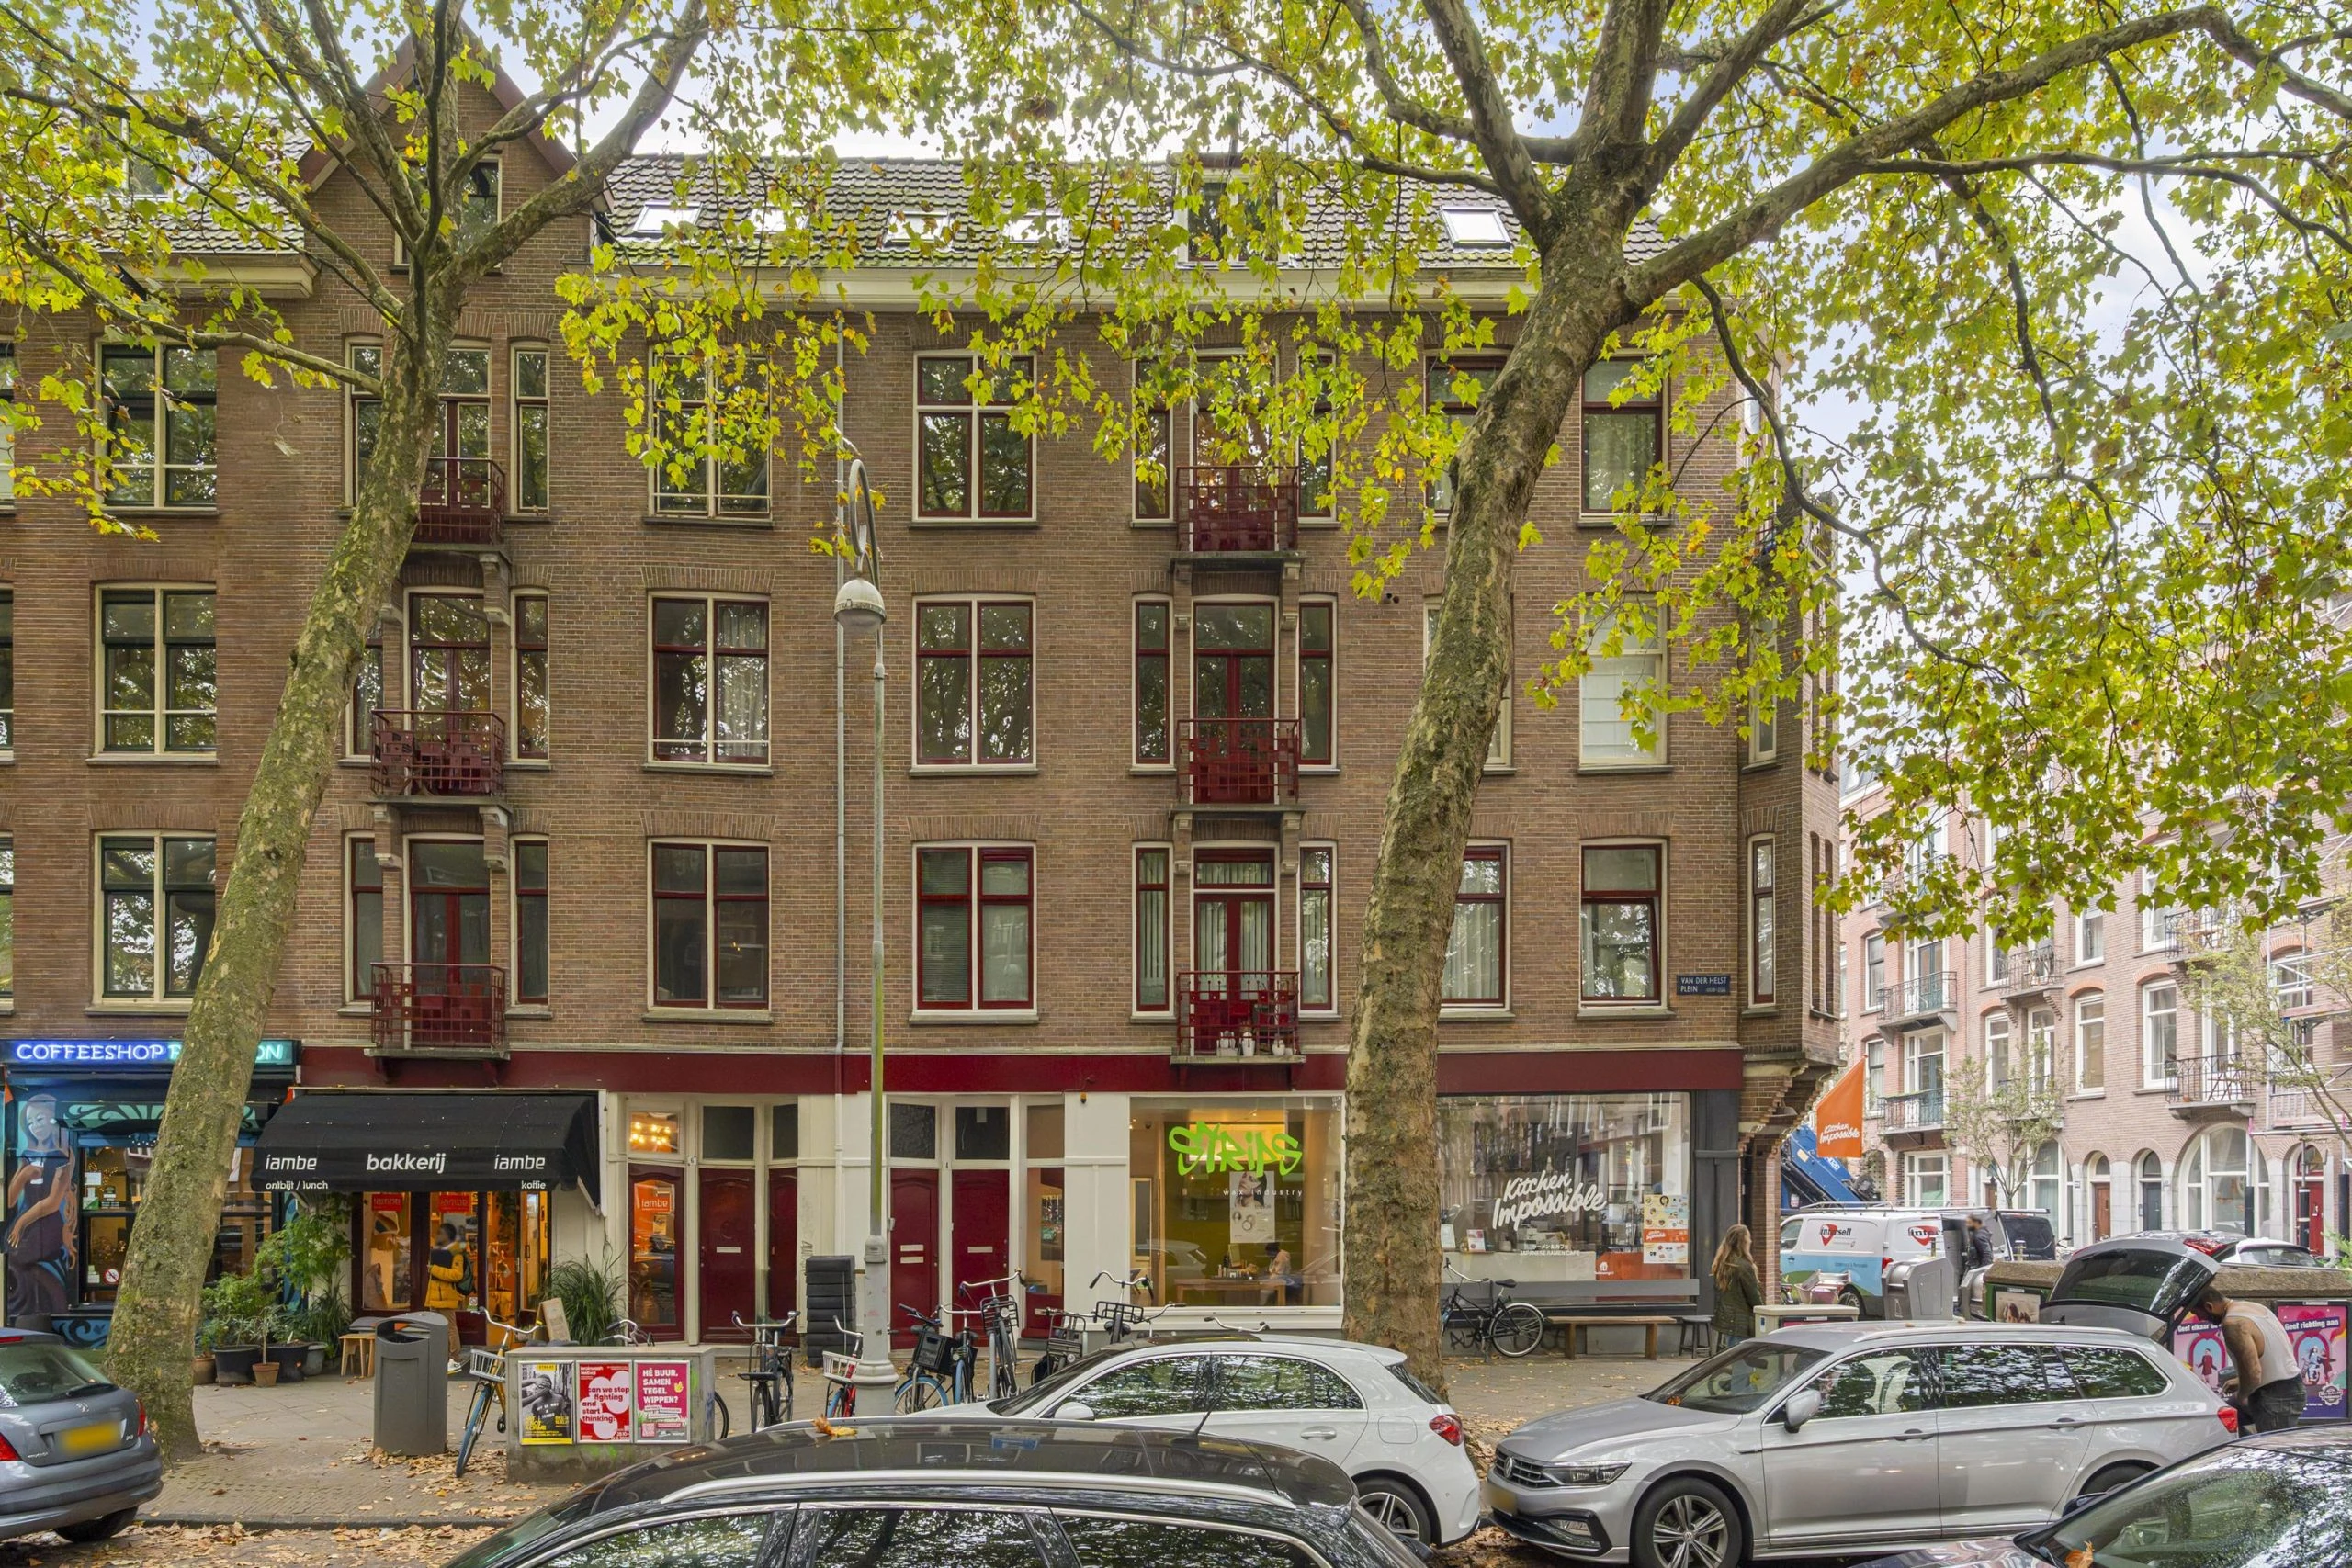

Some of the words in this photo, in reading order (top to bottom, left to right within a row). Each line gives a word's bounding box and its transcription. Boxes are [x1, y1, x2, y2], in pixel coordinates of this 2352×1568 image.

[17, 1043, 164, 1060] COFFEESHOP
[265, 1154, 317, 1170] iambe
[366, 1153, 447, 1174] bakkerij
[493, 1154, 546, 1170] iambe
[265, 1180, 294, 1190] ontbijt
[302, 1180, 329, 1190] lunch
[521, 1180, 546, 1190] koffie
[1252, 1188, 1303, 1197] industry
[1503, 1169, 1572, 1202] Kitchen
[1492, 1182, 1607, 1232] Impossible
[2284, 1322, 2299, 1331] Geef
[2300, 1319, 2325, 1329] richting
[2326, 1319, 2339, 1327] aan
[642, 1368, 653, 1376] HÉ
